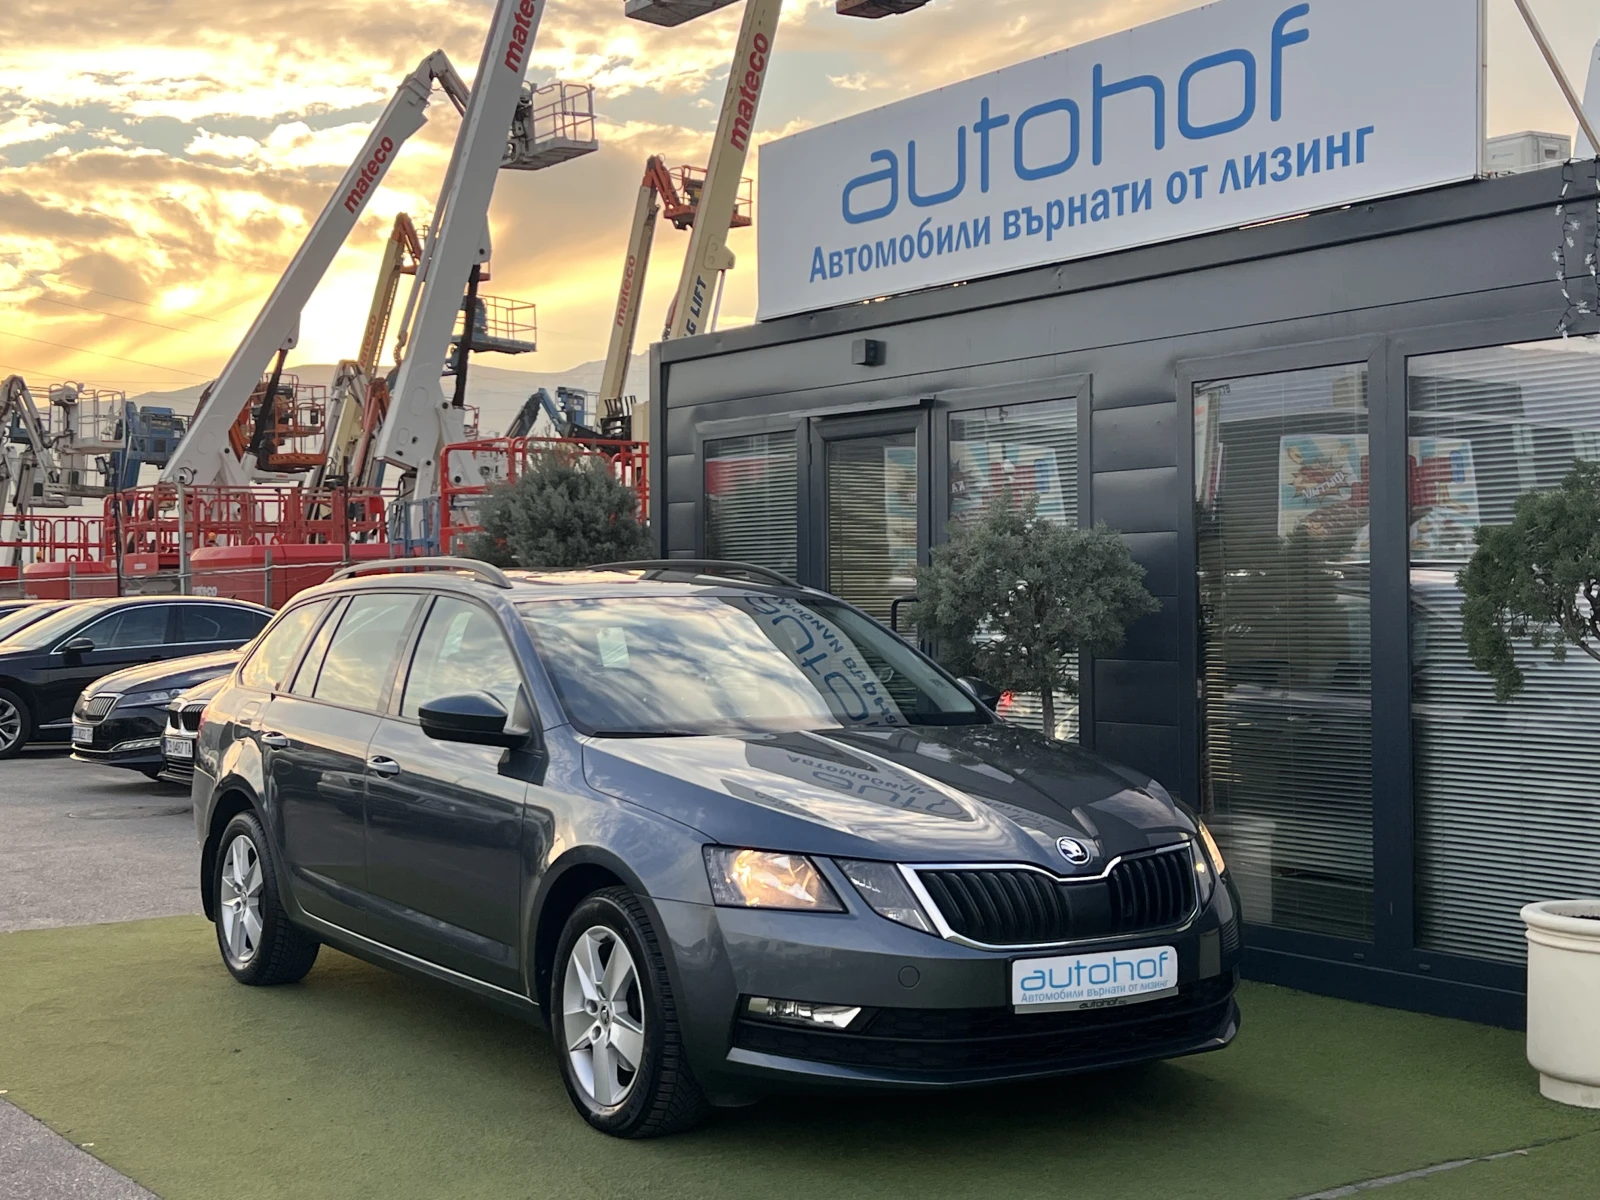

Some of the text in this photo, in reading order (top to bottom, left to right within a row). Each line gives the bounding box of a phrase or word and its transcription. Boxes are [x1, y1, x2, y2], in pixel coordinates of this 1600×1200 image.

[504, 0, 536, 73] mate
[730, 32, 769, 152] mateco
[842, 3, 1310, 224] autohof
[344, 136, 394, 214] mateco
[809, 125, 1375, 283] Автомобили върнати от лизинг
[616, 254, 636, 328] mateco
[684, 275, 707, 338] G LIFT
[1020, 951, 1169, 992] autohof
[1021, 979, 1170, 1003] Автомобили върнати от лизинг
